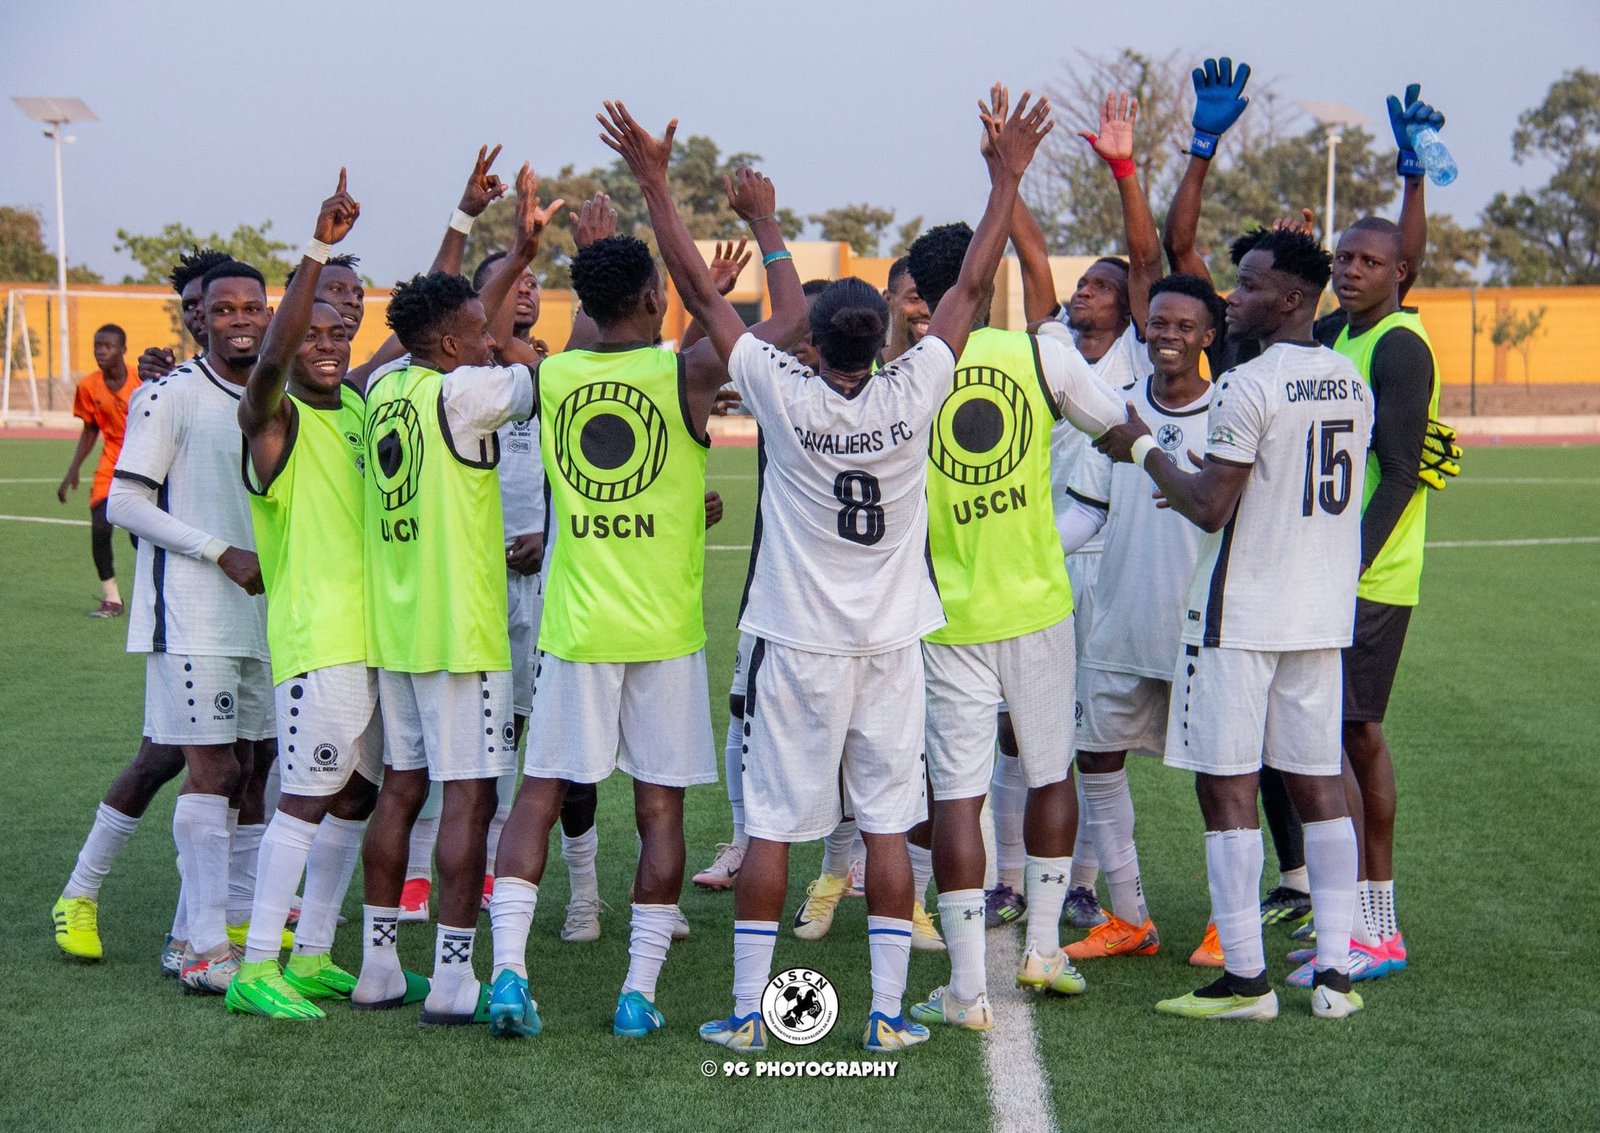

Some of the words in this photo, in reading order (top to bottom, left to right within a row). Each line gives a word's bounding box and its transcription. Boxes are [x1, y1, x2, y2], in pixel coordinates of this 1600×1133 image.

[1352, 380, 1363, 401] FC
[794, 426, 884, 454] CAVALIERS
[890, 420, 913, 446] FC
[1302, 419, 1354, 517] 15
[833, 469, 886, 546] 8
[953, 484, 1027, 525] USCN
[381, 517, 419, 543] UCN
[571, 514, 655, 539] USCN
